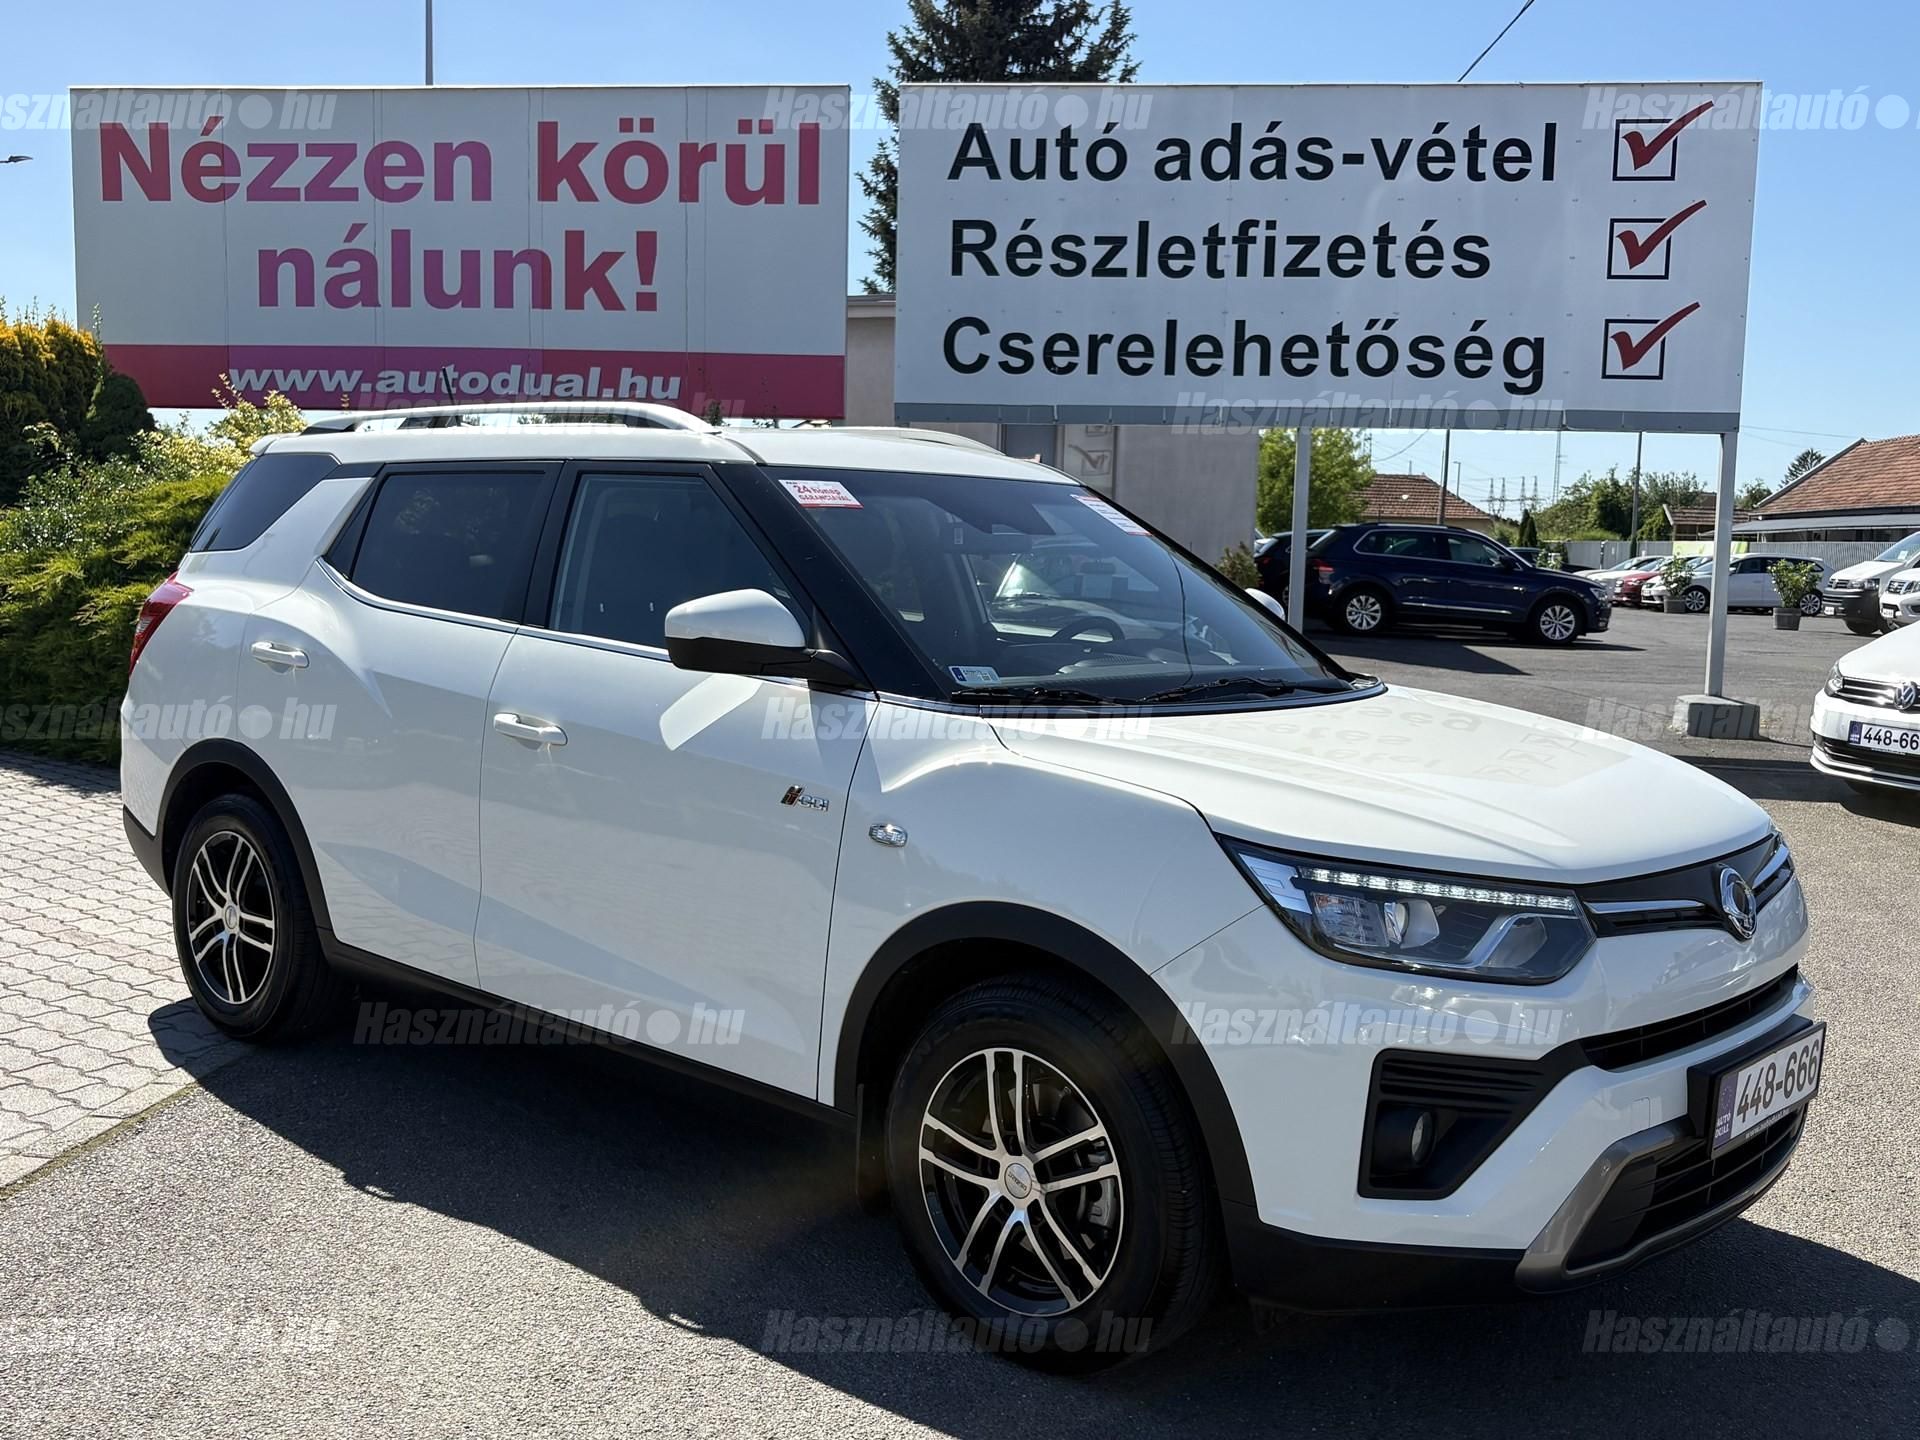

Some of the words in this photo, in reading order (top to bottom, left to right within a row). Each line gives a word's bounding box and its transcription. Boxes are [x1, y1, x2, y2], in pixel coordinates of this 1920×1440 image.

[100, 115, 493, 204] Nézzen
[537, 117, 821, 206] körül
[947, 121, 1128, 182] Autó
[1154, 120, 1557, 182] adás-vétel
[257, 222, 659, 312] nálunk!
[950, 218, 1491, 279] Részletfizetés
[229, 363, 682, 400] www.autodual.hu
[943, 316, 1546, 396] Cserelehetőség
[1736, 1039, 1820, 1123] 448-666
